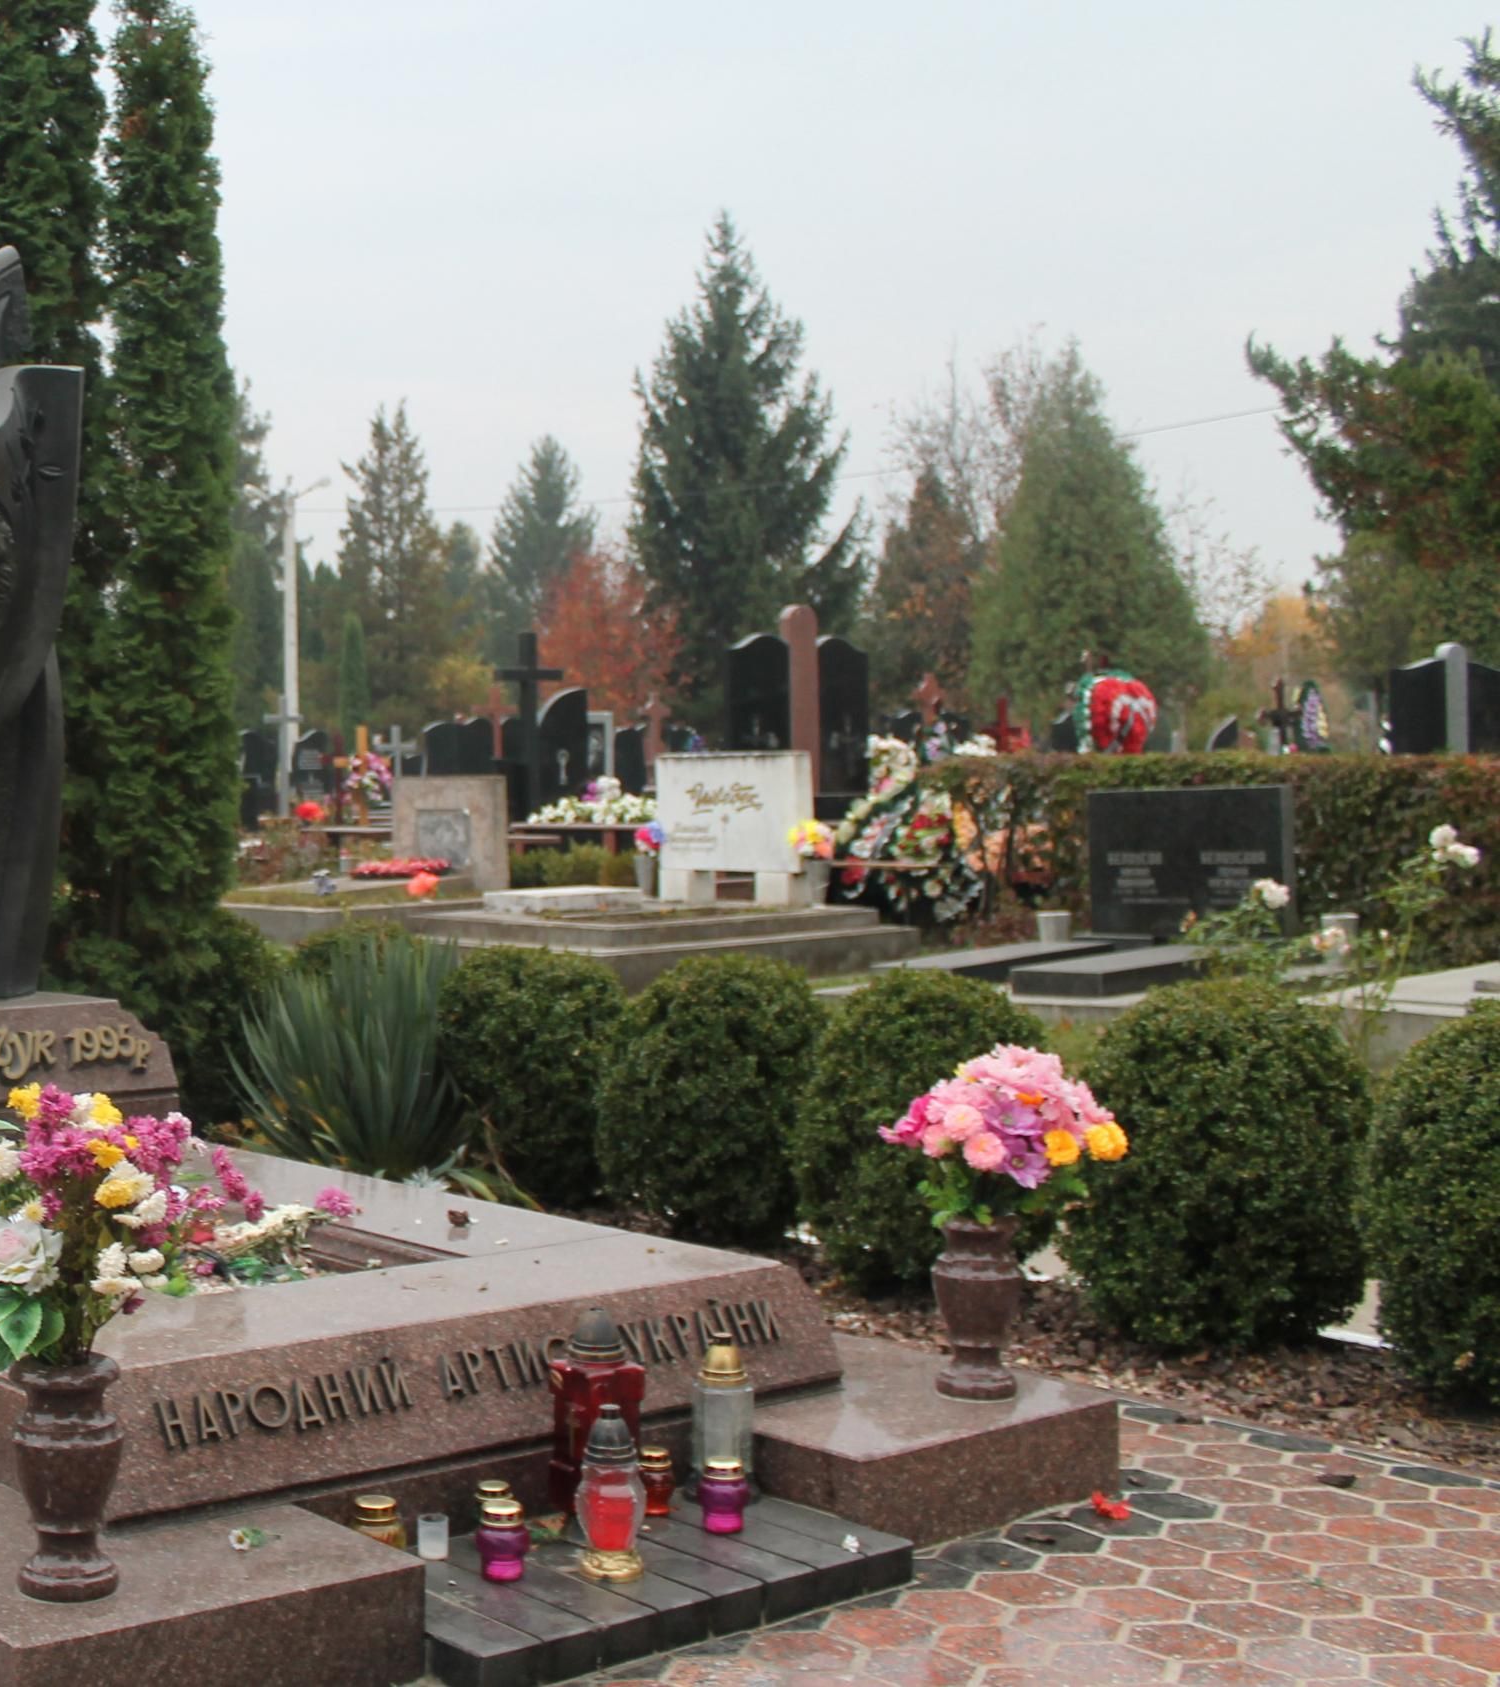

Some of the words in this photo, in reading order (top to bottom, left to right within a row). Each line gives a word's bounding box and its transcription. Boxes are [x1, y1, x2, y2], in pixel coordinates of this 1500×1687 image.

[155, 1355, 414, 1451] НАРОДНИЙ
[437, 1334, 569, 1401] АРТИС
[618, 1298, 782, 1366] УКРАЇНИ
